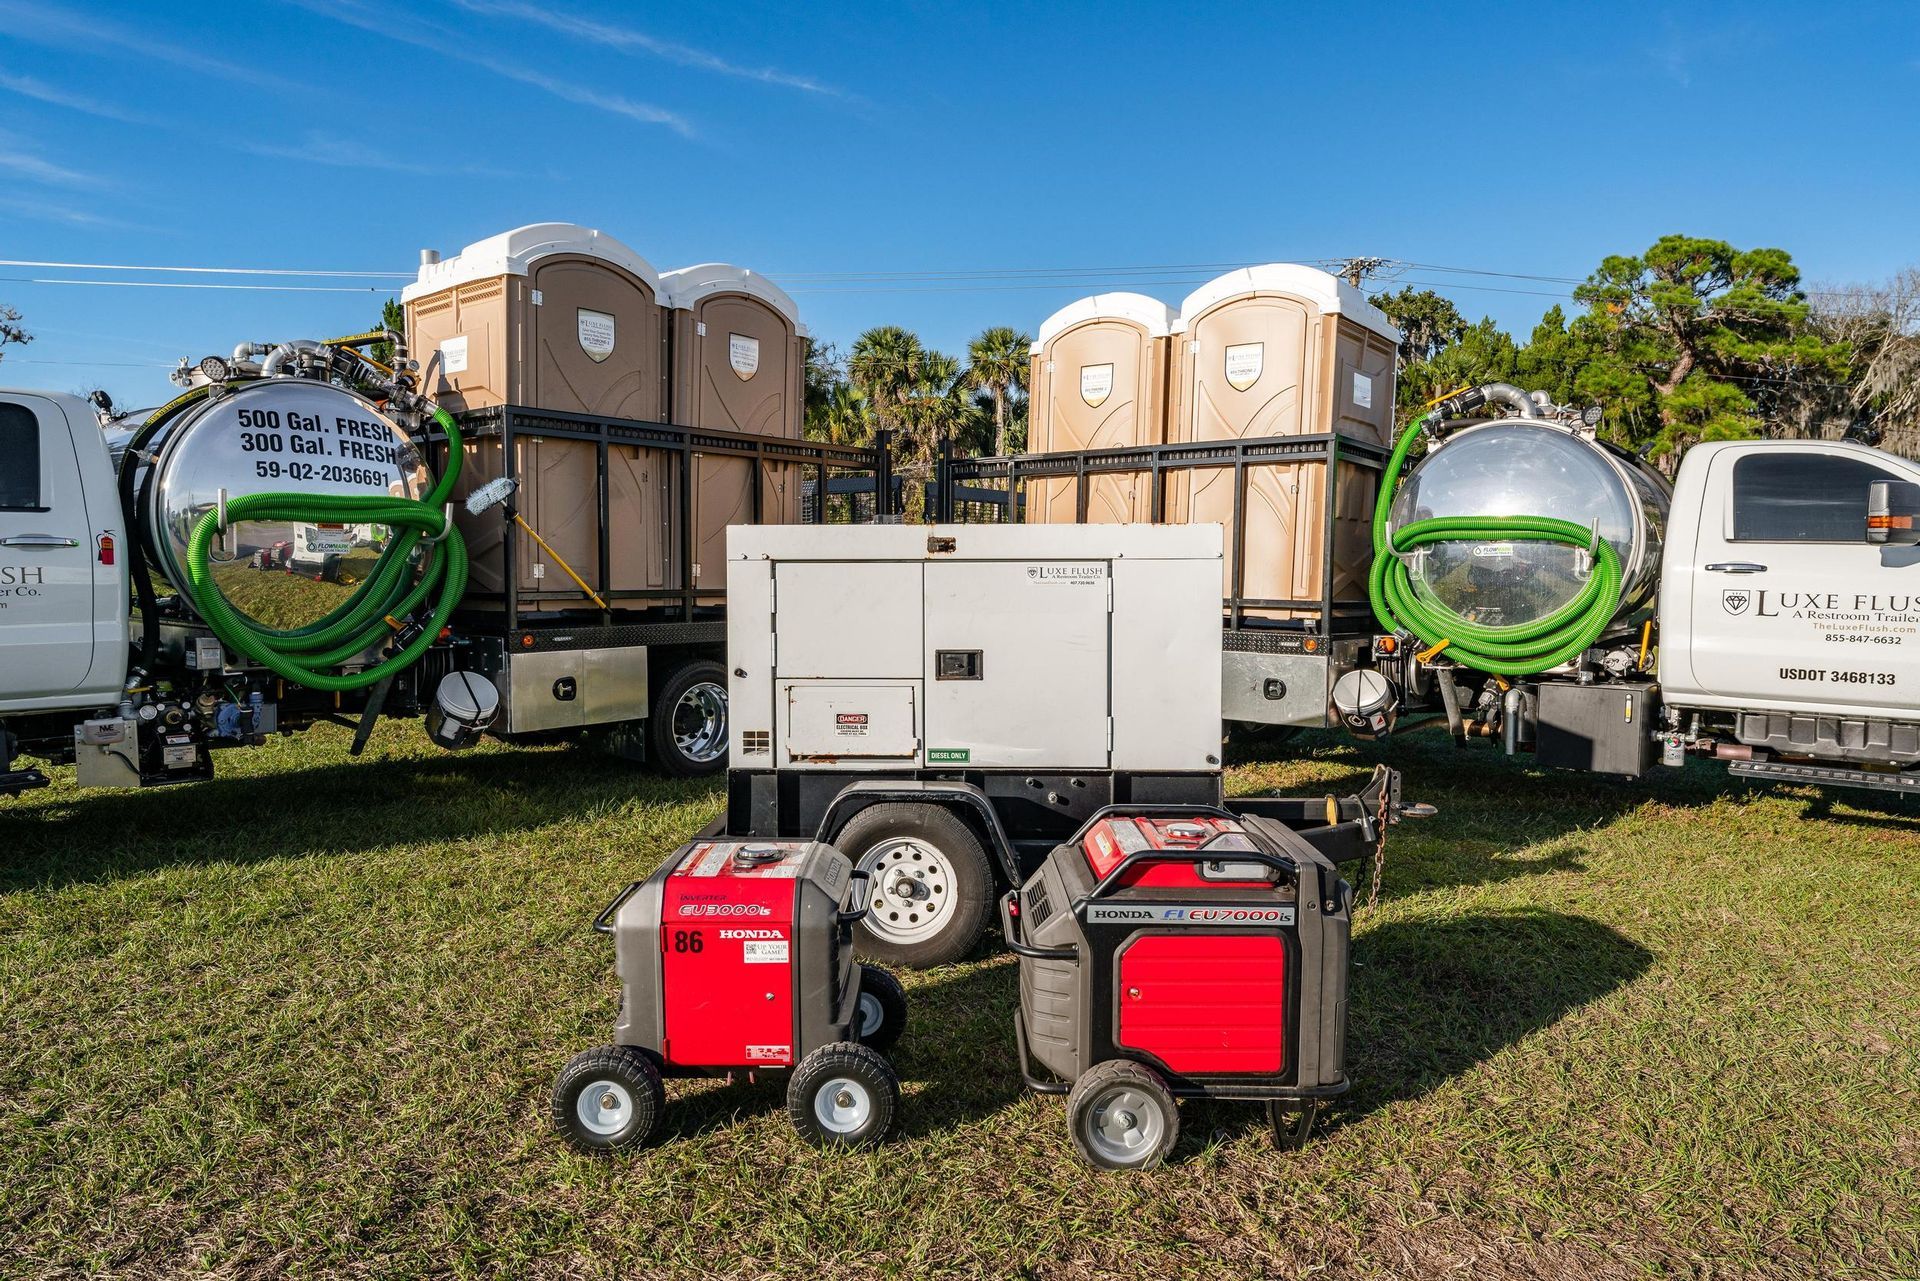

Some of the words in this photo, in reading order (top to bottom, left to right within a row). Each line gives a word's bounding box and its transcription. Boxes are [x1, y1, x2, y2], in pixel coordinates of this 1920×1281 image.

[238, 409, 280, 429] 500
[287, 412, 329, 433] Gal.
[335, 417, 394, 443] FRESH
[240, 433, 283, 452] 300
[290, 434, 332, 456] Gal.
[339, 439, 397, 465] FRESH
[256, 460, 389, 488] 59-Q2-2036691
[1040, 566, 1067, 579] LUXE
[1071, 567, 1103, 575] FLUSH
[16, 586, 41, 597] Co.
[1755, 590, 1839, 617] LUXE
[1792, 610, 1803, 619] A
[1807, 610, 1870, 621] Restroom
[1813, 622, 1916, 633] TheLuxeFlush.com
[1825, 633, 1902, 645] 855-847-6632
[1779, 667, 1827, 682] USDOT
[1831, 671, 1896, 685] 3468133
[838, 715, 866, 723] DANGER
[825, 857, 842, 886] HONDA
[1094, 910, 1154, 918] HONDA
[1189, 909, 1291, 922] EU7000is
[720, 930, 784, 939] HONDA
[675, 931, 703, 954] 86
